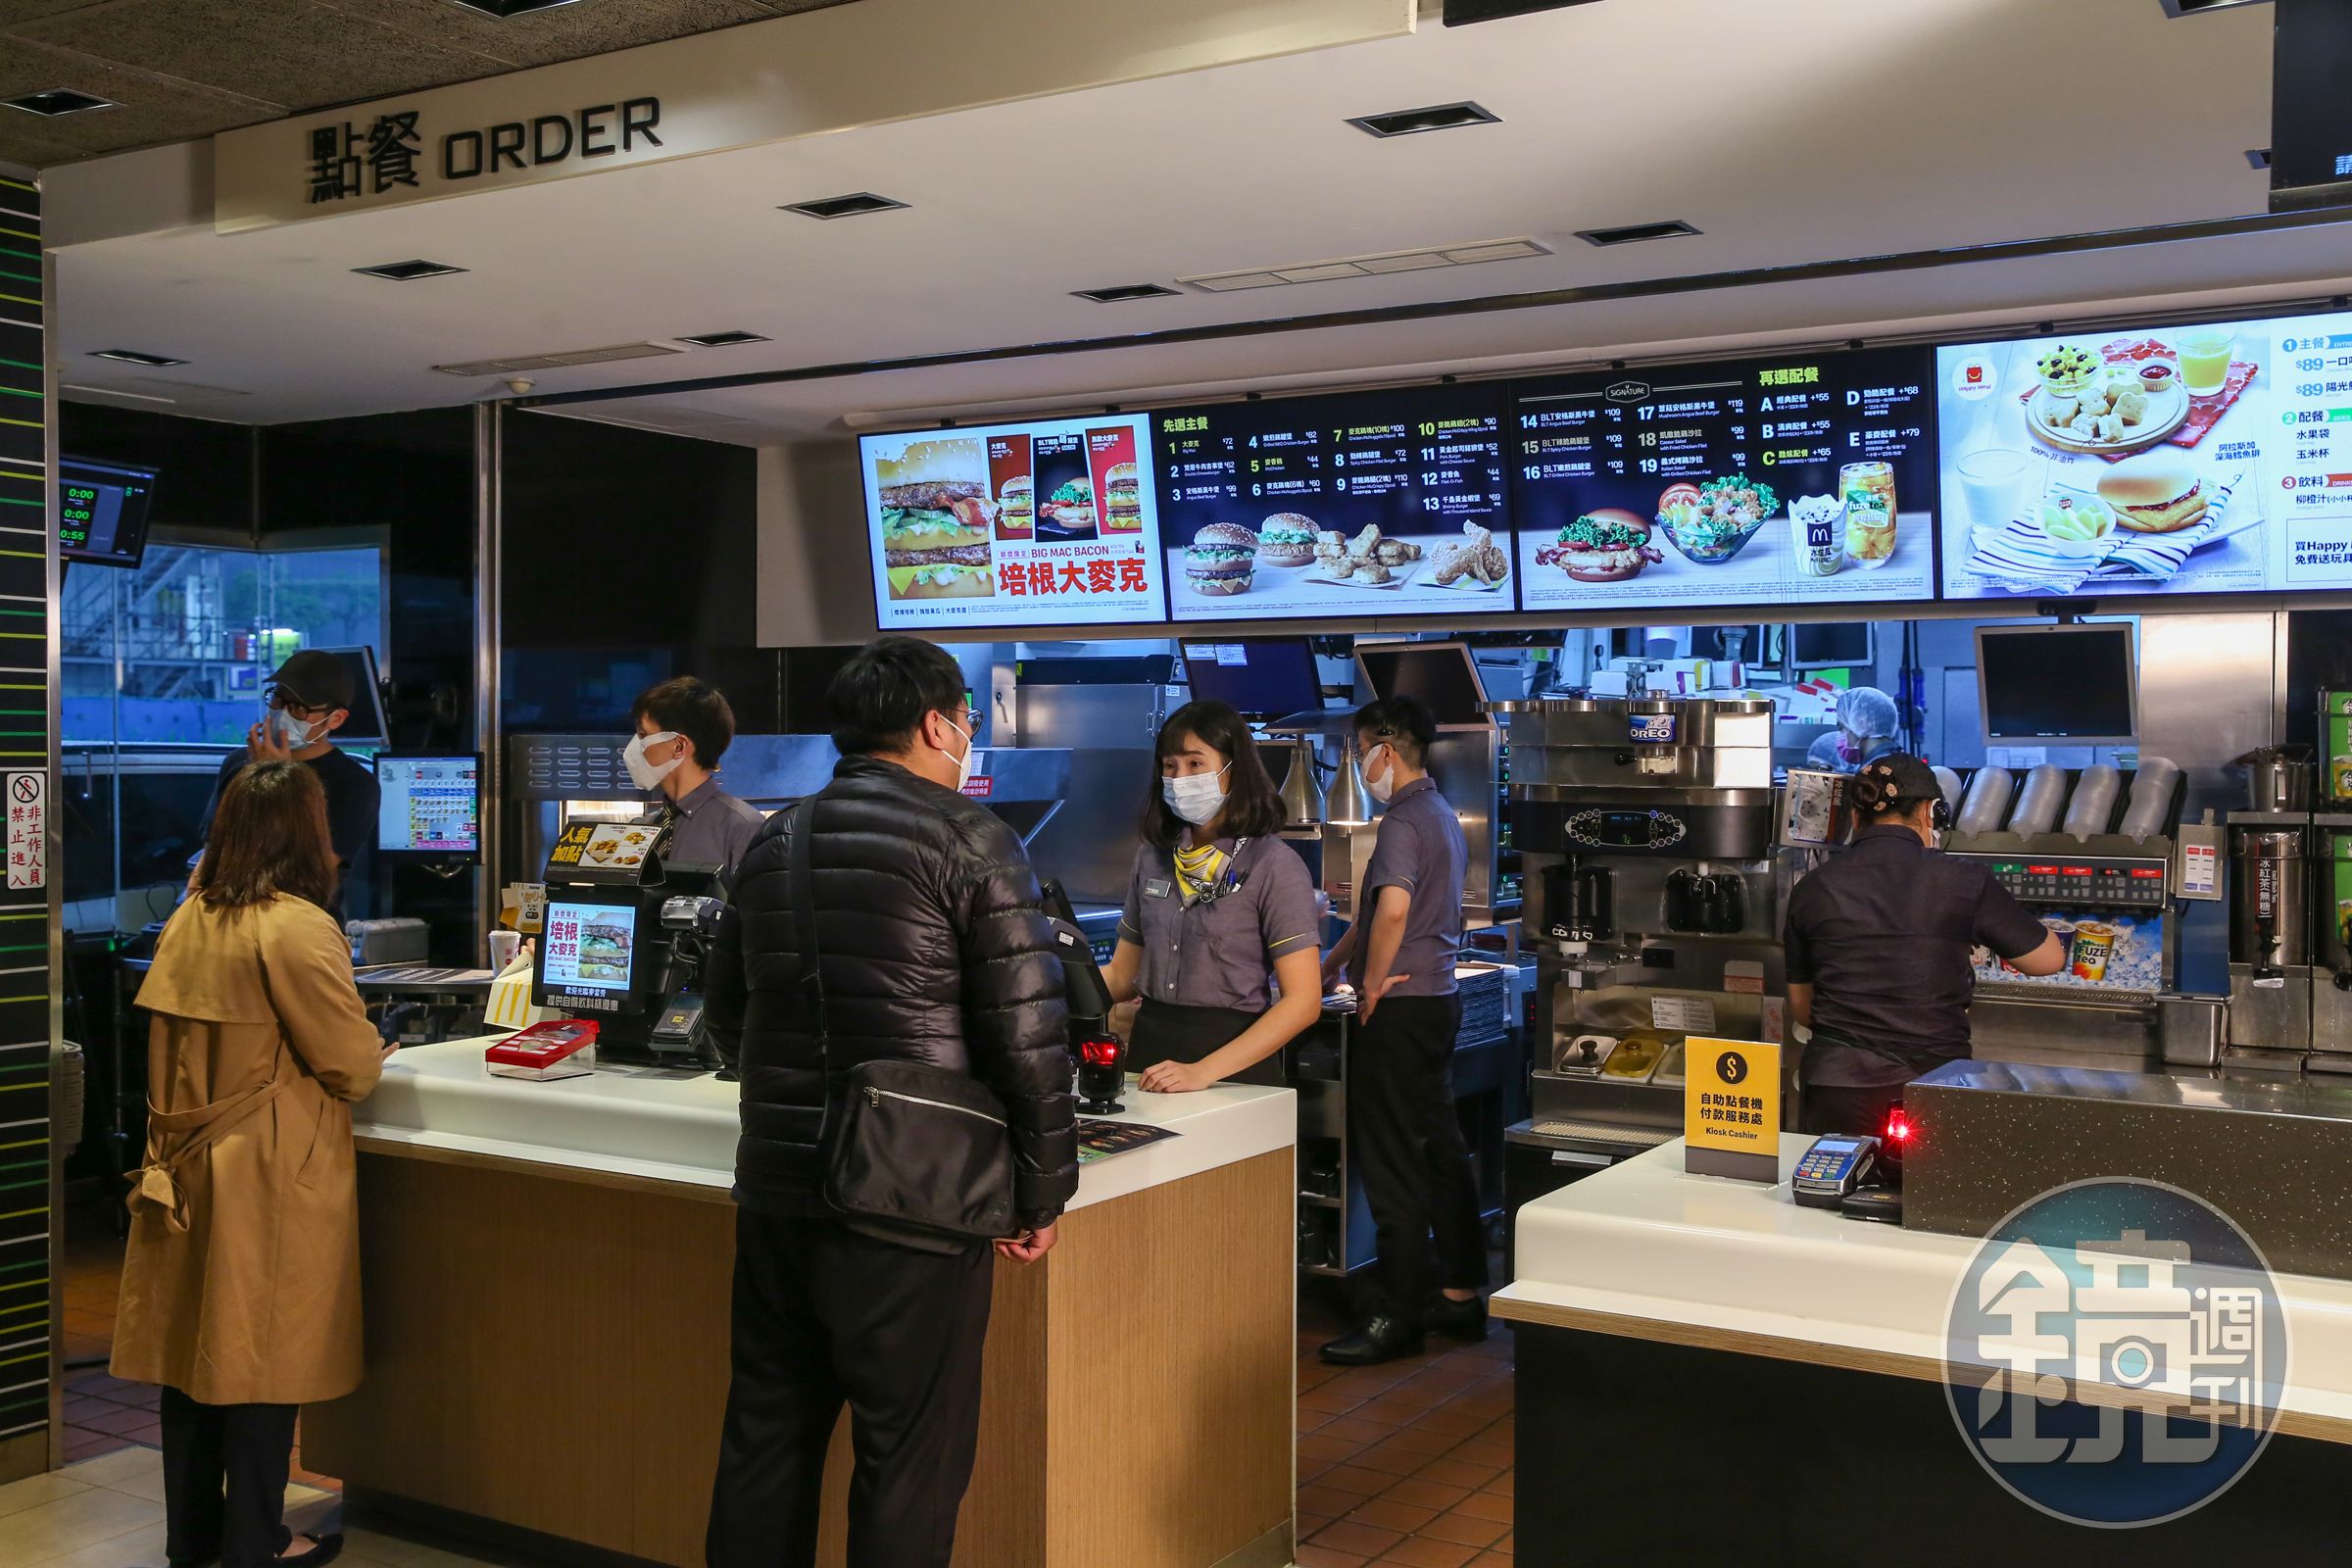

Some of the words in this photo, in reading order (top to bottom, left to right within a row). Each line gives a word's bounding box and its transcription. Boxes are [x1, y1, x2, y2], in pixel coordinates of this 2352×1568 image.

[311, 111, 421, 204] 點餐
[445, 96, 663, 180] ORDER
[2299, 337, 2325, 350] 主餐
[2296, 358, 2324, 371] $89
[1759, 367, 1819, 386] 再選配餐
[1610, 384, 1644, 397] SIGNATURE
[2296, 383, 2324, 397] $89
[1760, 397, 1773, 412] A
[1846, 391, 1860, 406] D
[1638, 406, 1654, 419] 17
[2299, 411, 2324, 422] 配餐
[1520, 415, 1538, 428] 14
[1334, 429, 1342, 442] 7
[1419, 422, 1435, 436] 10
[1762, 424, 1775, 438] B
[2296, 428, 2329, 440] 水果袋
[1249, 436, 1257, 448] 4
[1639, 433, 1656, 447] 18
[1849, 432, 1860, 447] E
[1169, 442, 1176, 454] 1
[1522, 440, 1540, 455] 15
[2296, 448, 2329, 460] 玉米杯
[1335, 454, 1345, 466] 8
[1421, 448, 1435, 461] 11
[1762, 451, 1776, 466] C
[1171, 466, 1179, 477] 2
[1250, 461, 1259, 472] 5
[1640, 459, 1657, 472] 19
[1422, 472, 1438, 485] 12
[1523, 466, 1541, 480] 16
[1337, 478, 1346, 491] 9
[2298, 475, 2324, 487] 飲料
[69, 489, 94, 500] 0:00
[1173, 489, 1181, 501] 3
[1252, 483, 1261, 496] 6
[1423, 497, 1440, 511] 13
[65, 510, 89, 519] 0:00
[60, 530, 85, 540] 0:55
[1031, 549, 1048, 558] BIG
[1050, 547, 1072, 558] MAC
[1074, 545, 1109, 557] BACON
[999, 558, 1148, 596] 培根大麥克
[1630, 728, 1671, 738] OREO
[560, 826, 593, 844] 人氣
[11, 806, 26, 887] 禁止進入
[26, 805, 43, 885] 非工作人員
[551, 845, 584, 863] 加點
[2259, 858, 2271, 915] 冰紅茶(無糖)
[550, 920, 578, 942] 培根
[549, 942, 577, 956] 大麥克
[2079, 946, 2108, 957] FUZE
[1700, 1093, 1763, 1110] 自助點餐機
[1700, 1106, 1763, 1125] 付款服務處
[1706, 1126, 1728, 1137] Kiosk
[1728, 1128, 1758, 1140] Cashier
